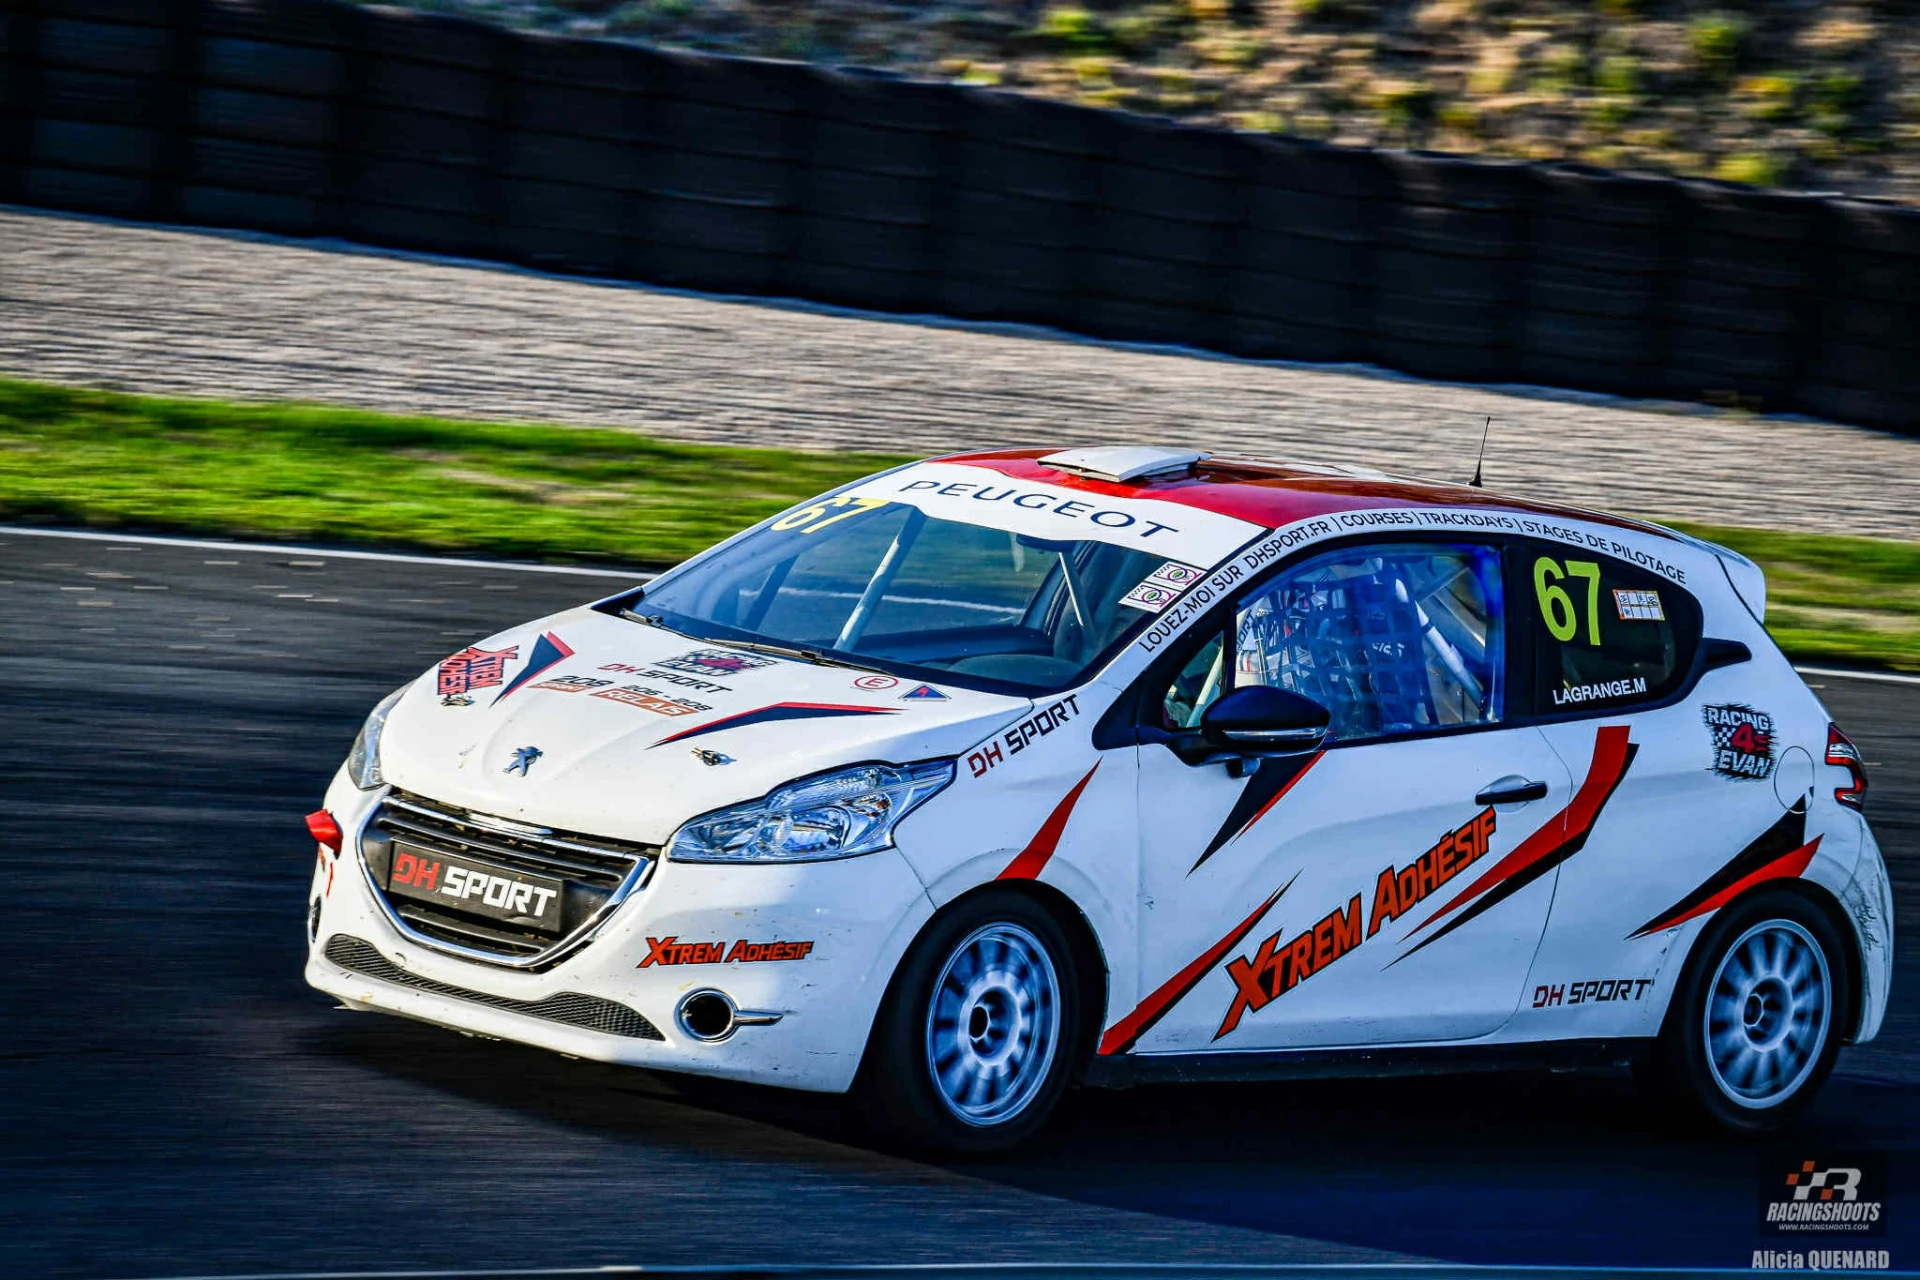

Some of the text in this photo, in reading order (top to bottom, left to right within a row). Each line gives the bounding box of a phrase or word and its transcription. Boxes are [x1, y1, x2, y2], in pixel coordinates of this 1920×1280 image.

[770, 497, 889, 534] 67
[898, 480, 1179, 538] PEUGEOT
[1138, 585, 1216, 653] LOUEZ-MOI
[1211, 565, 1244, 593] SUR
[1243, 520, 1332, 570] DHSPORT.FR
[1341, 511, 1414, 527] COURSES
[1420, 512, 1513, 529] TRACKDAYS
[1522, 520, 1584, 544] STAGES
[1586, 534, 1609, 552] DE
[1611, 541, 1687, 585] PILOTAGE
[1533, 556, 1601, 646] 67
[597, 663, 733, 695] DH SPORT
[1551, 677, 1648, 705] LAGRANGE.M
[967, 693, 1080, 779] DH SPORT
[1706, 707, 1771, 731] RACING
[1717, 750, 1772, 778] EVAN
[392, 852, 558, 917] DH SPORT
[1209, 803, 1497, 1044] XTREM ADHÉSIF
[636, 936, 726, 969] XTREM
[1532, 979, 1653, 1009] DH SPORT
